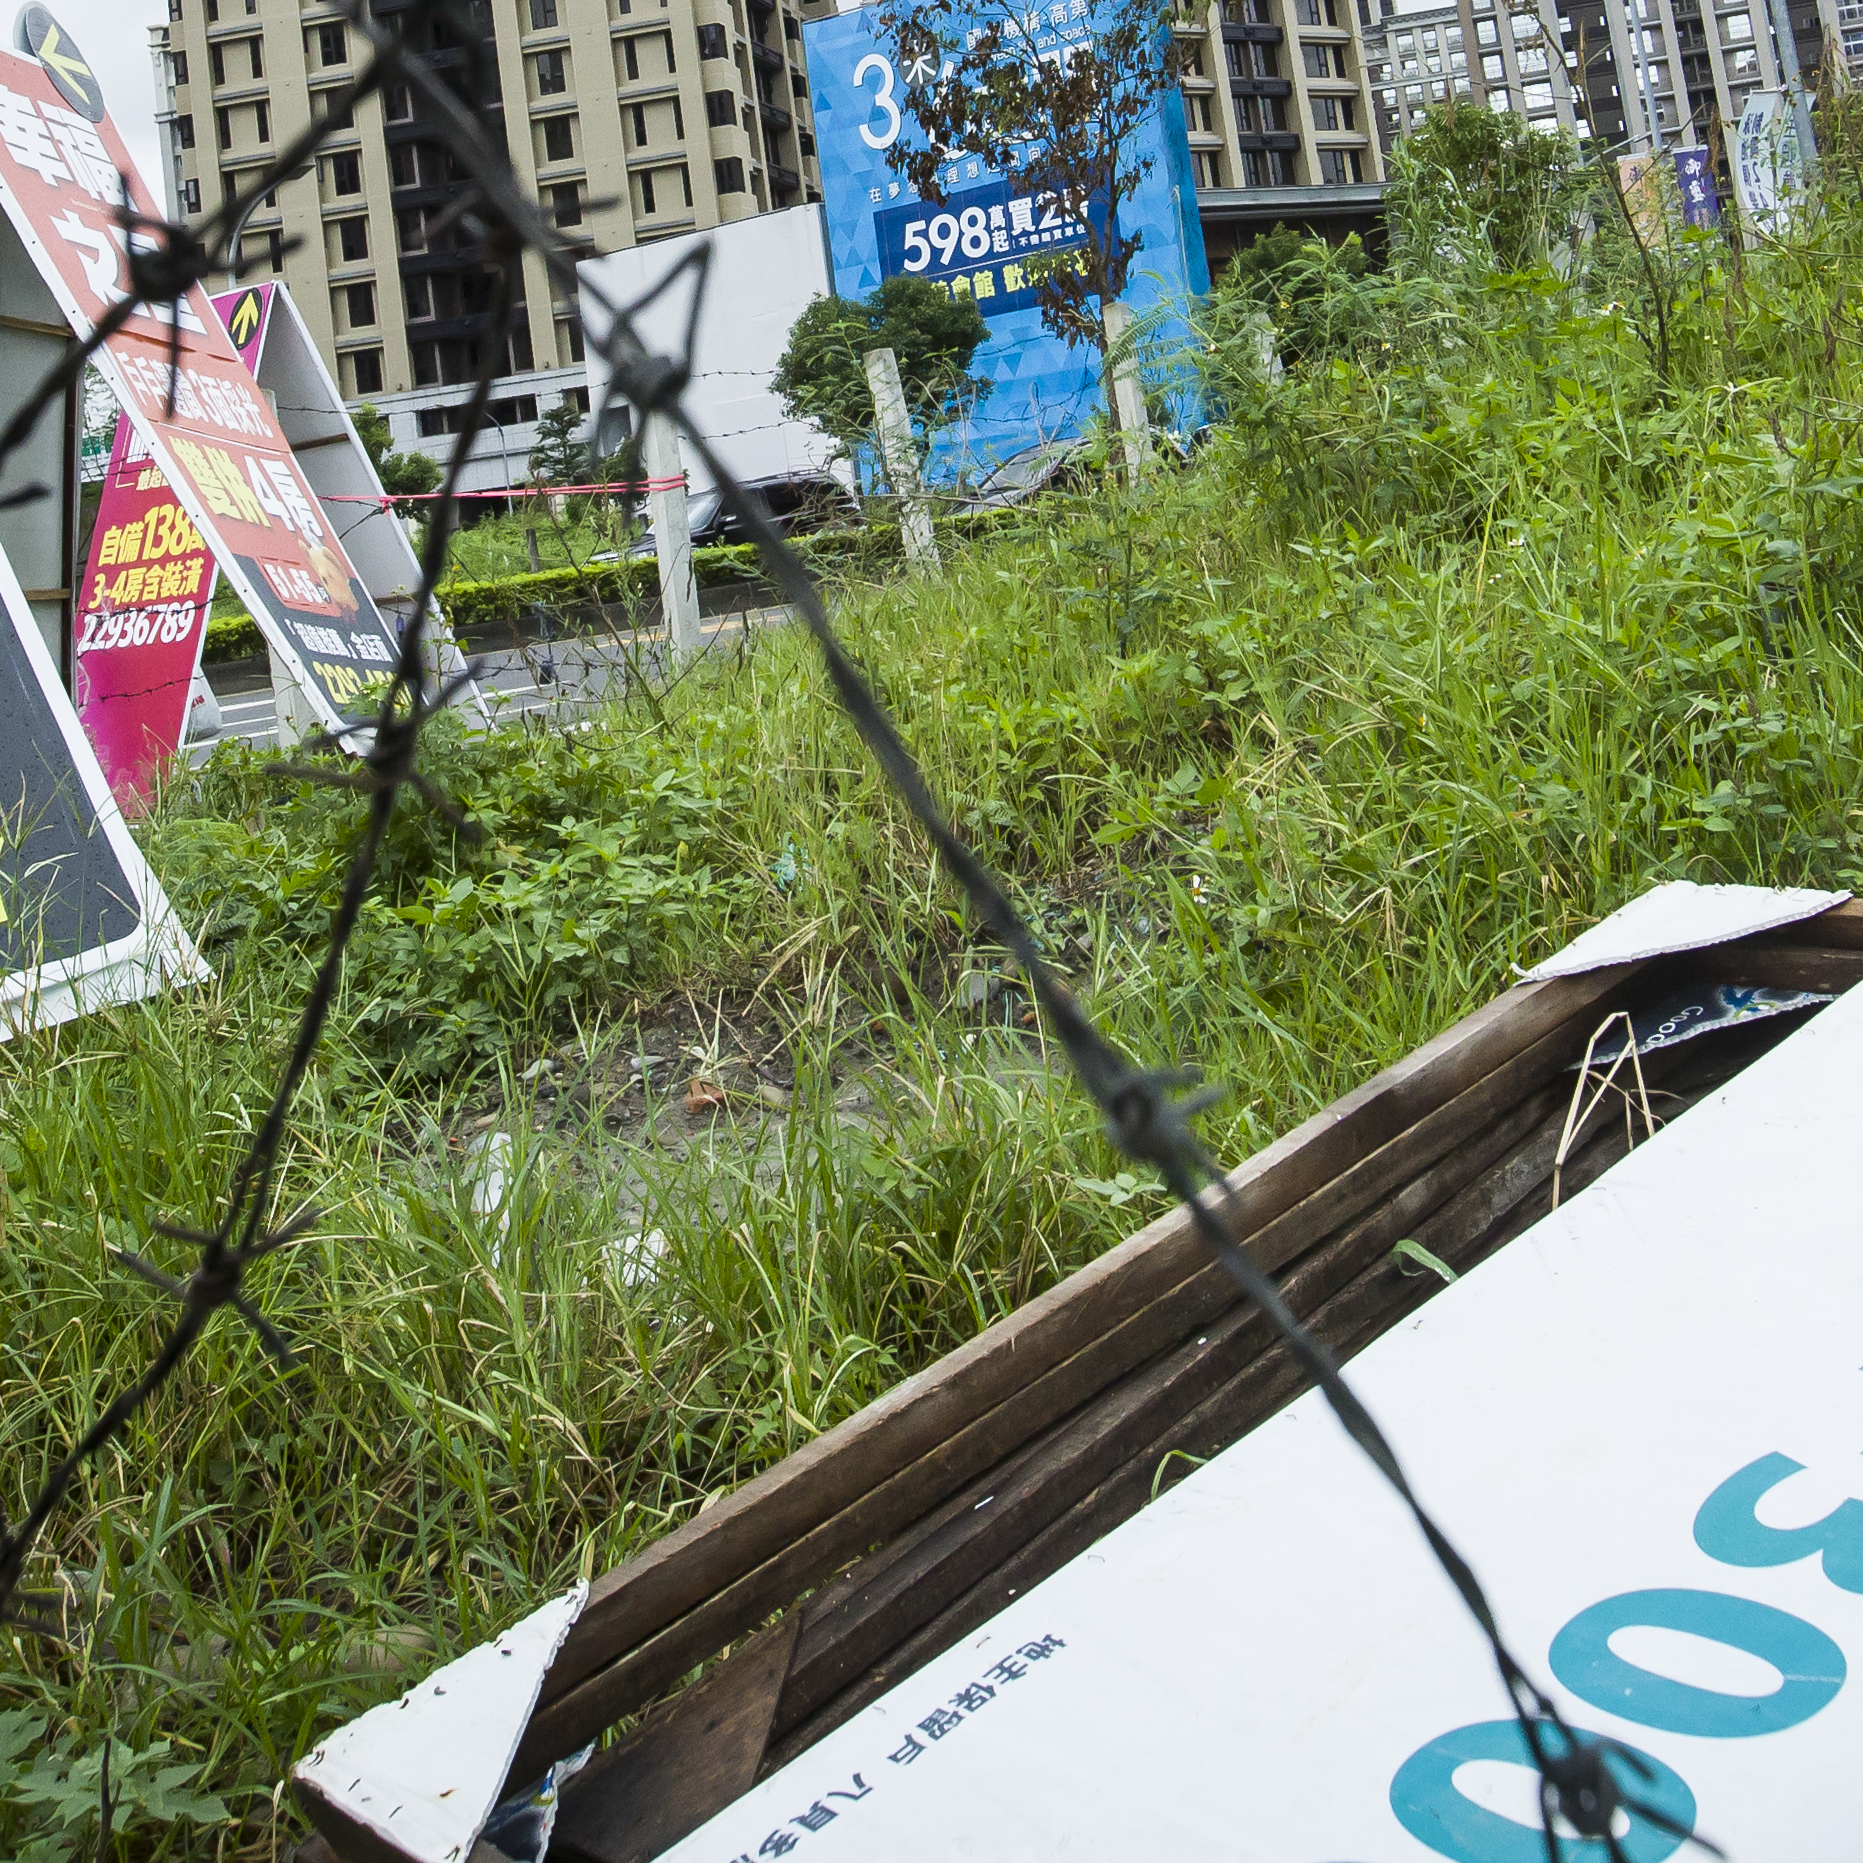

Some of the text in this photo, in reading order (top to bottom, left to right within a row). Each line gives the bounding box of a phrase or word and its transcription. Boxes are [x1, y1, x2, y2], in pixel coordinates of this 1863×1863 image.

[87, 556, 205, 610] 3-4房含裝潢
[76, 599, 196, 653] 22936789
[886, 1633, 1069, 1766] 地主保留戶
